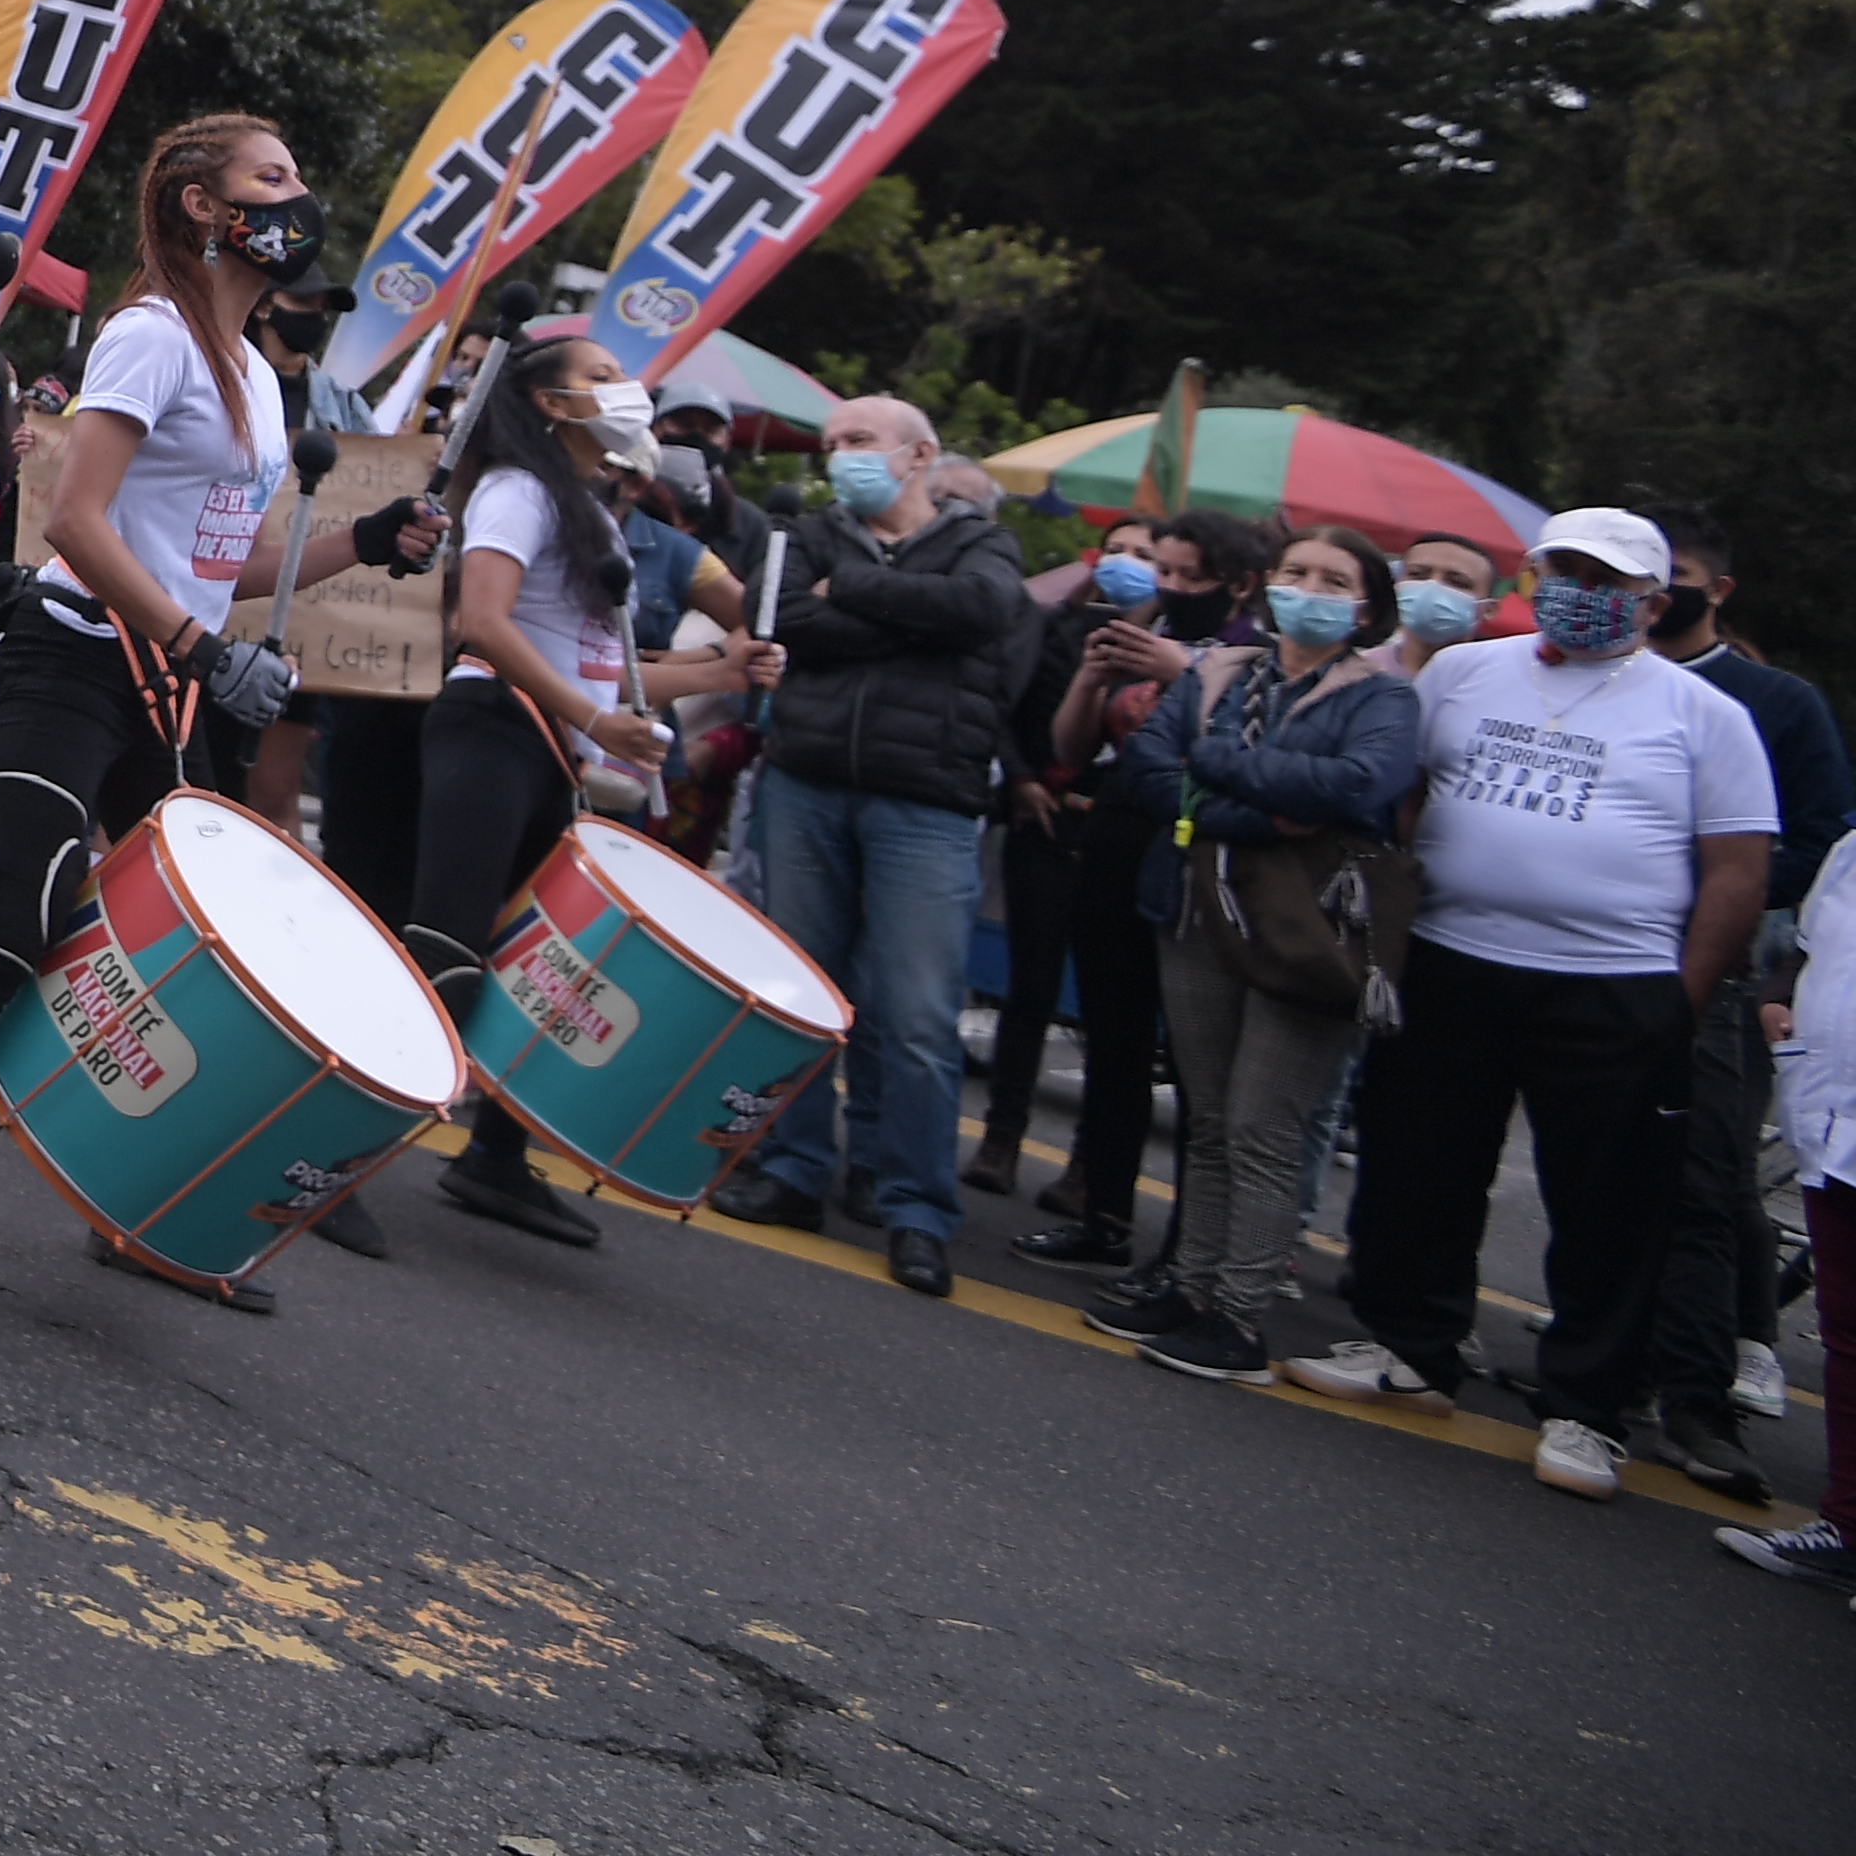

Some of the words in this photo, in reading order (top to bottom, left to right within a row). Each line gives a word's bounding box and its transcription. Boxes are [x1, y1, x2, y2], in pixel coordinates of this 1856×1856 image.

[409, 7, 672, 263] CUT
[207, 485, 228, 510] ES
[198, 510, 262, 536] MOMEN
[194, 534, 220, 559] DE
[217, 536, 254, 562] PAR
[1464, 739, 1484, 757] LA
[1476, 717, 1537, 744] TODOS
[1538, 730, 1607, 758] CONTRA
[1454, 779, 1586, 822] VOTAMOS
[94, 951, 164, 1041] COMTÉ
[511, 976, 535, 1005] DE
[527, 956, 604, 1043] NACIONAL
[51, 988, 81, 1026] DE
[69, 1021, 122, 1086] PARO
[72, 968, 158, 1086] NACIONAL
